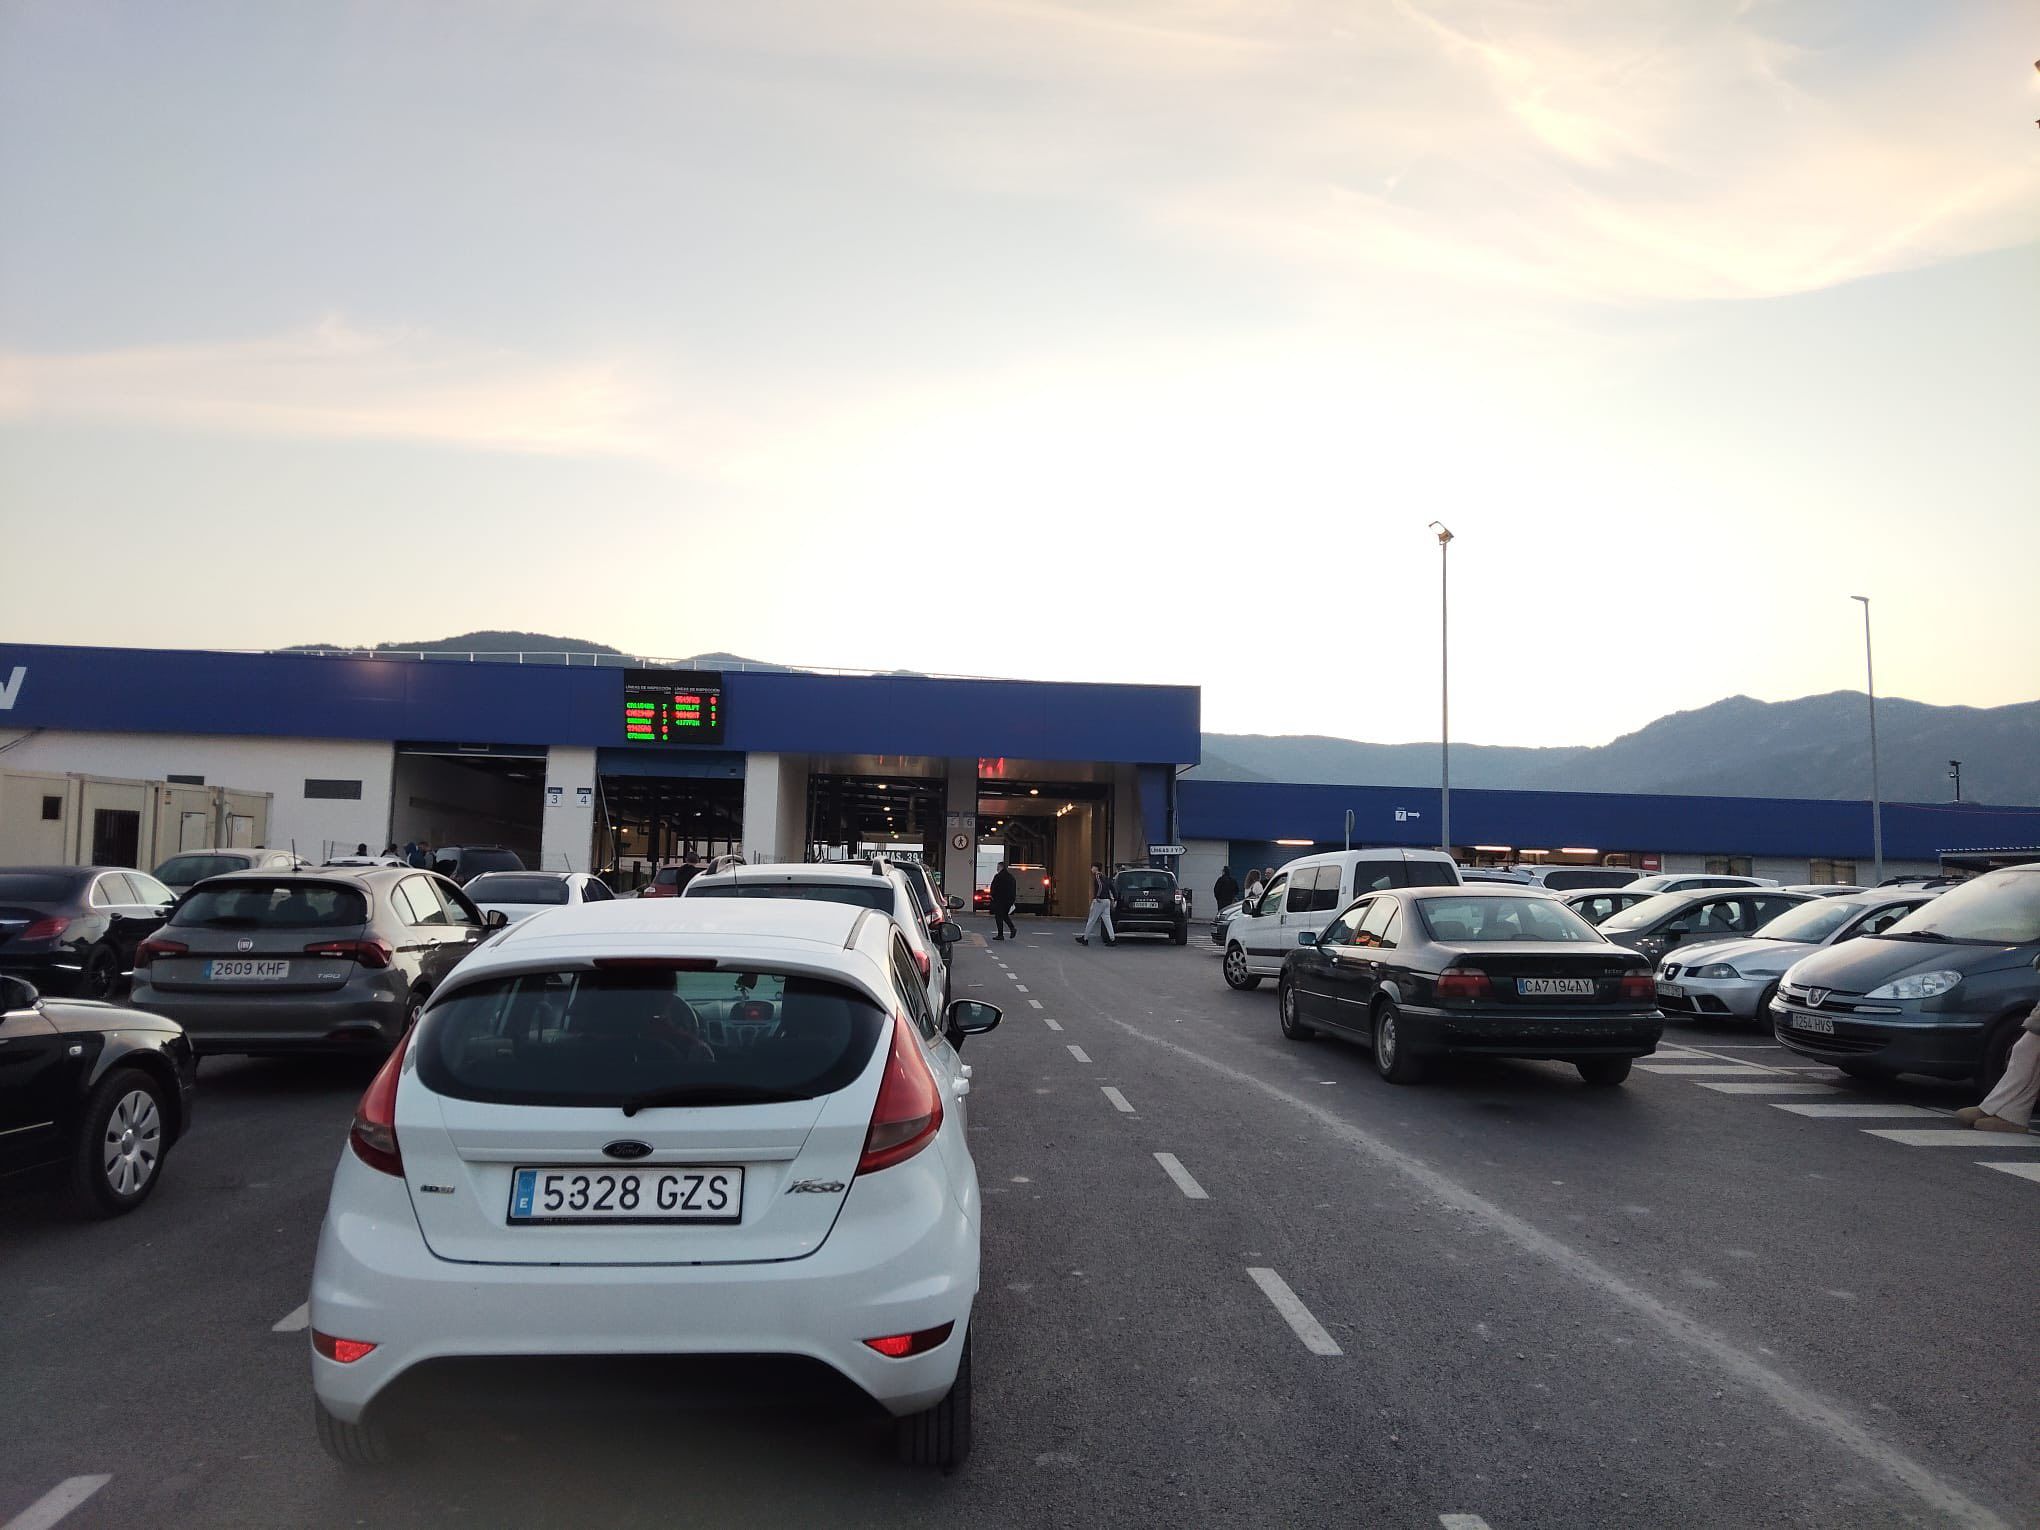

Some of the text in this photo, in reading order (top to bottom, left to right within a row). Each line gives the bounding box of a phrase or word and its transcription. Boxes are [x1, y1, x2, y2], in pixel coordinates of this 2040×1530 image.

[551, 794, 558, 804] 3
[580, 795, 588, 804] 4
[215, 962, 286, 976] 2609 KHF
[1525, 980, 1590, 993] CA7194AY
[1815, 1018, 1833, 1032] HVS
[543, 1175, 730, 1211] 5328 GZS
[519, 1197, 529, 1208] E
